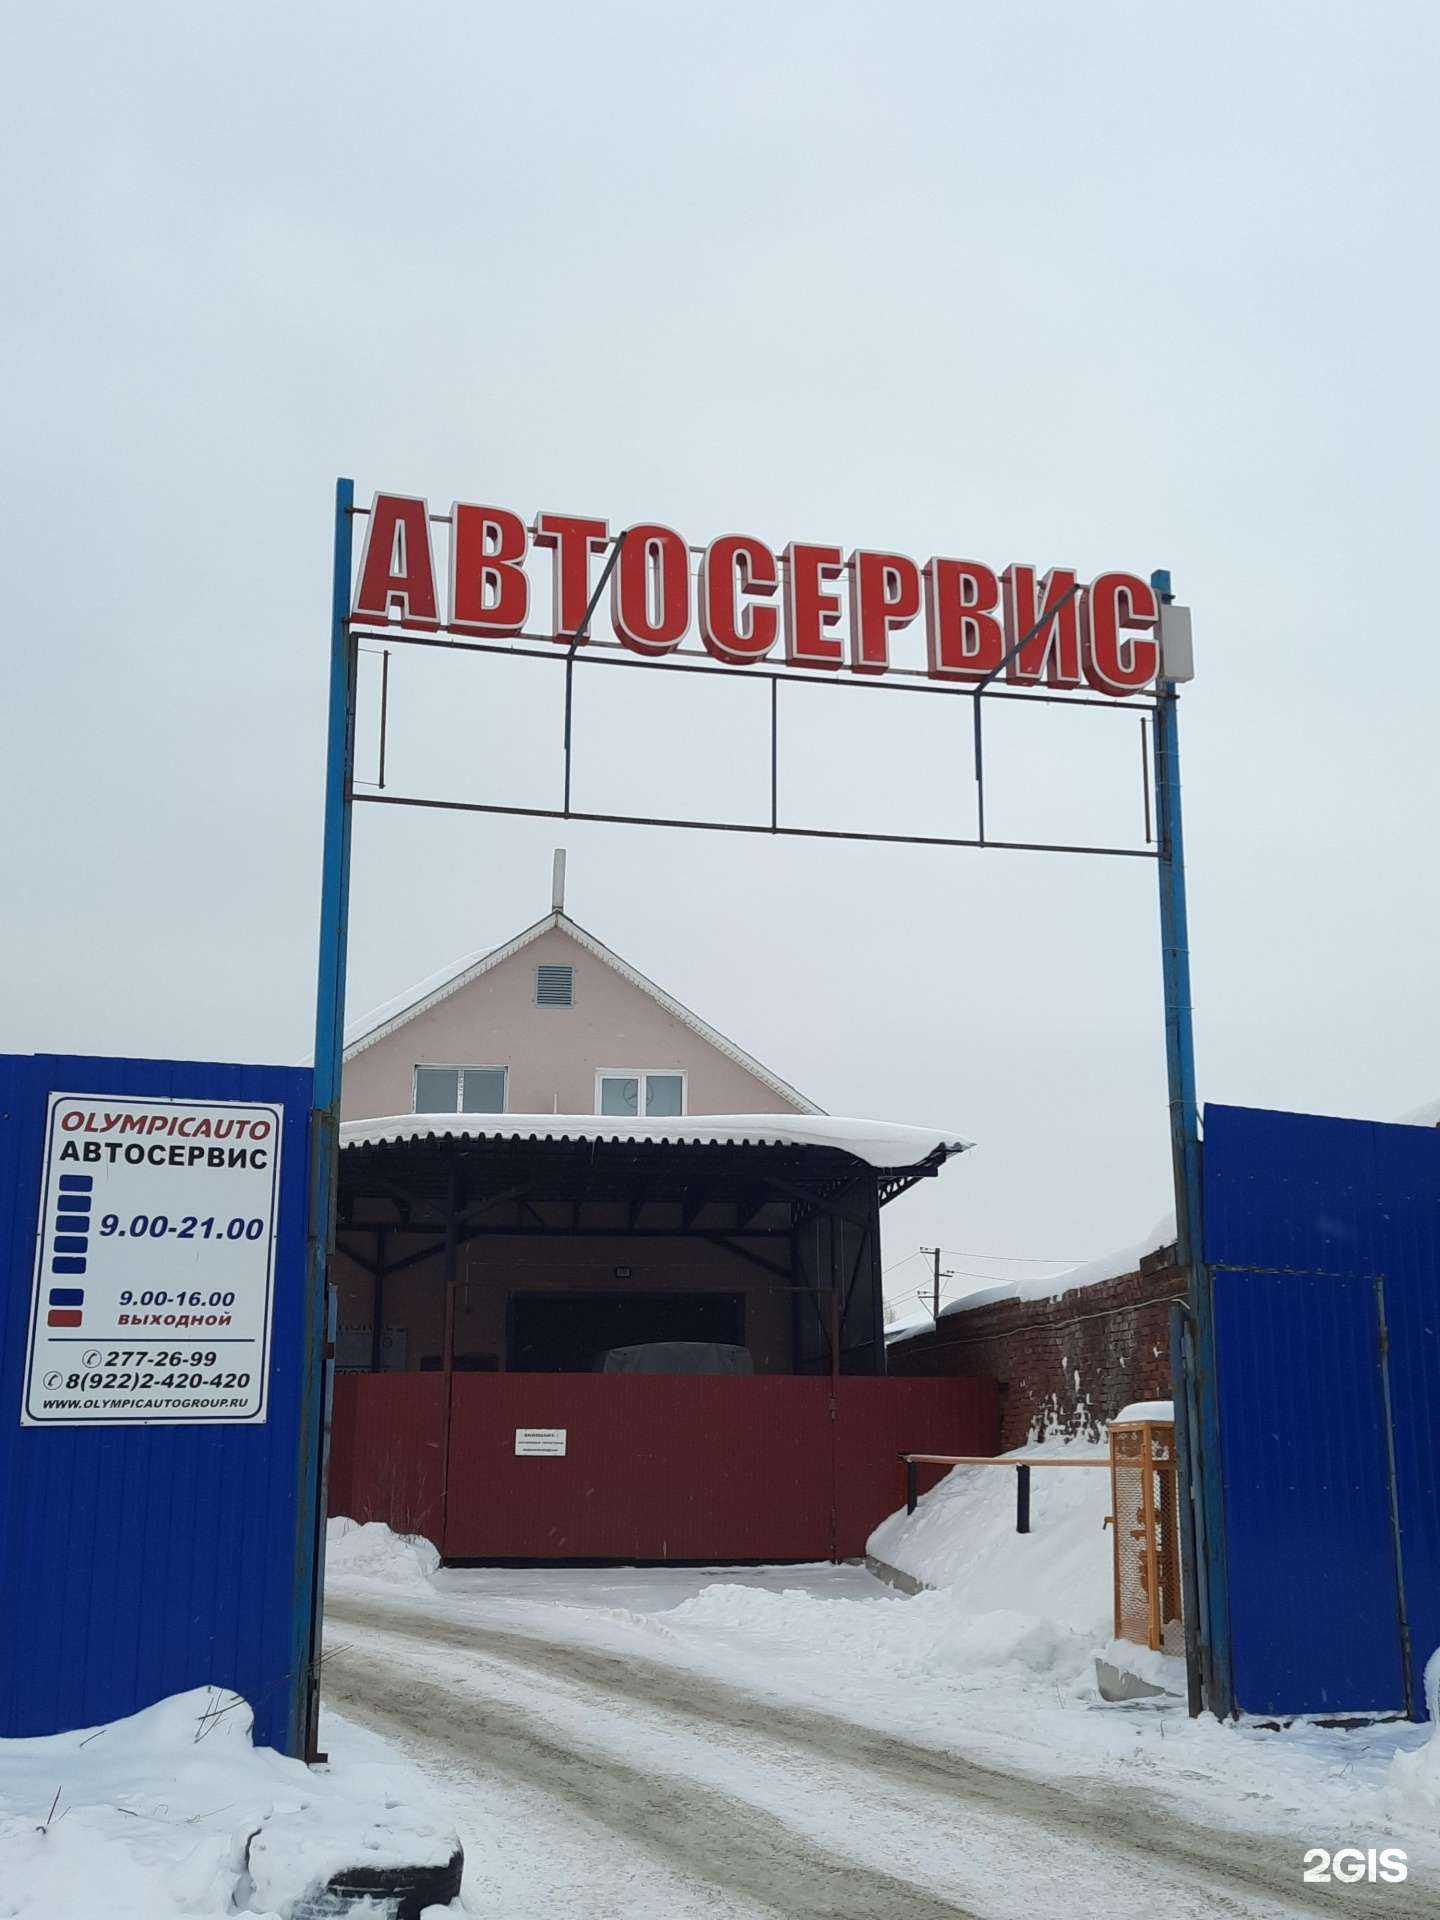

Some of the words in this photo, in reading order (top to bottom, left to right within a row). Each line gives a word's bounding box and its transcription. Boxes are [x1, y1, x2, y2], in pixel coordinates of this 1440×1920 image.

[352, 490, 1161, 698] АВТОСЕРВИС
[61, 1111, 271, 1141] OLYMPICAUTO
[59, 1141, 268, 1170] АВТОСЕРВИС
[99, 1214, 264, 1240] 9.00-21.00
[119, 1291, 235, 1307] 9.00-16.00
[104, 1351, 217, 1367] 277-26-99
[65, 1372, 250, 1391] 8(922)2-420-420
[43, 1398, 248, 1410] WWW.OLYMPICAUTOGROUP.RU
